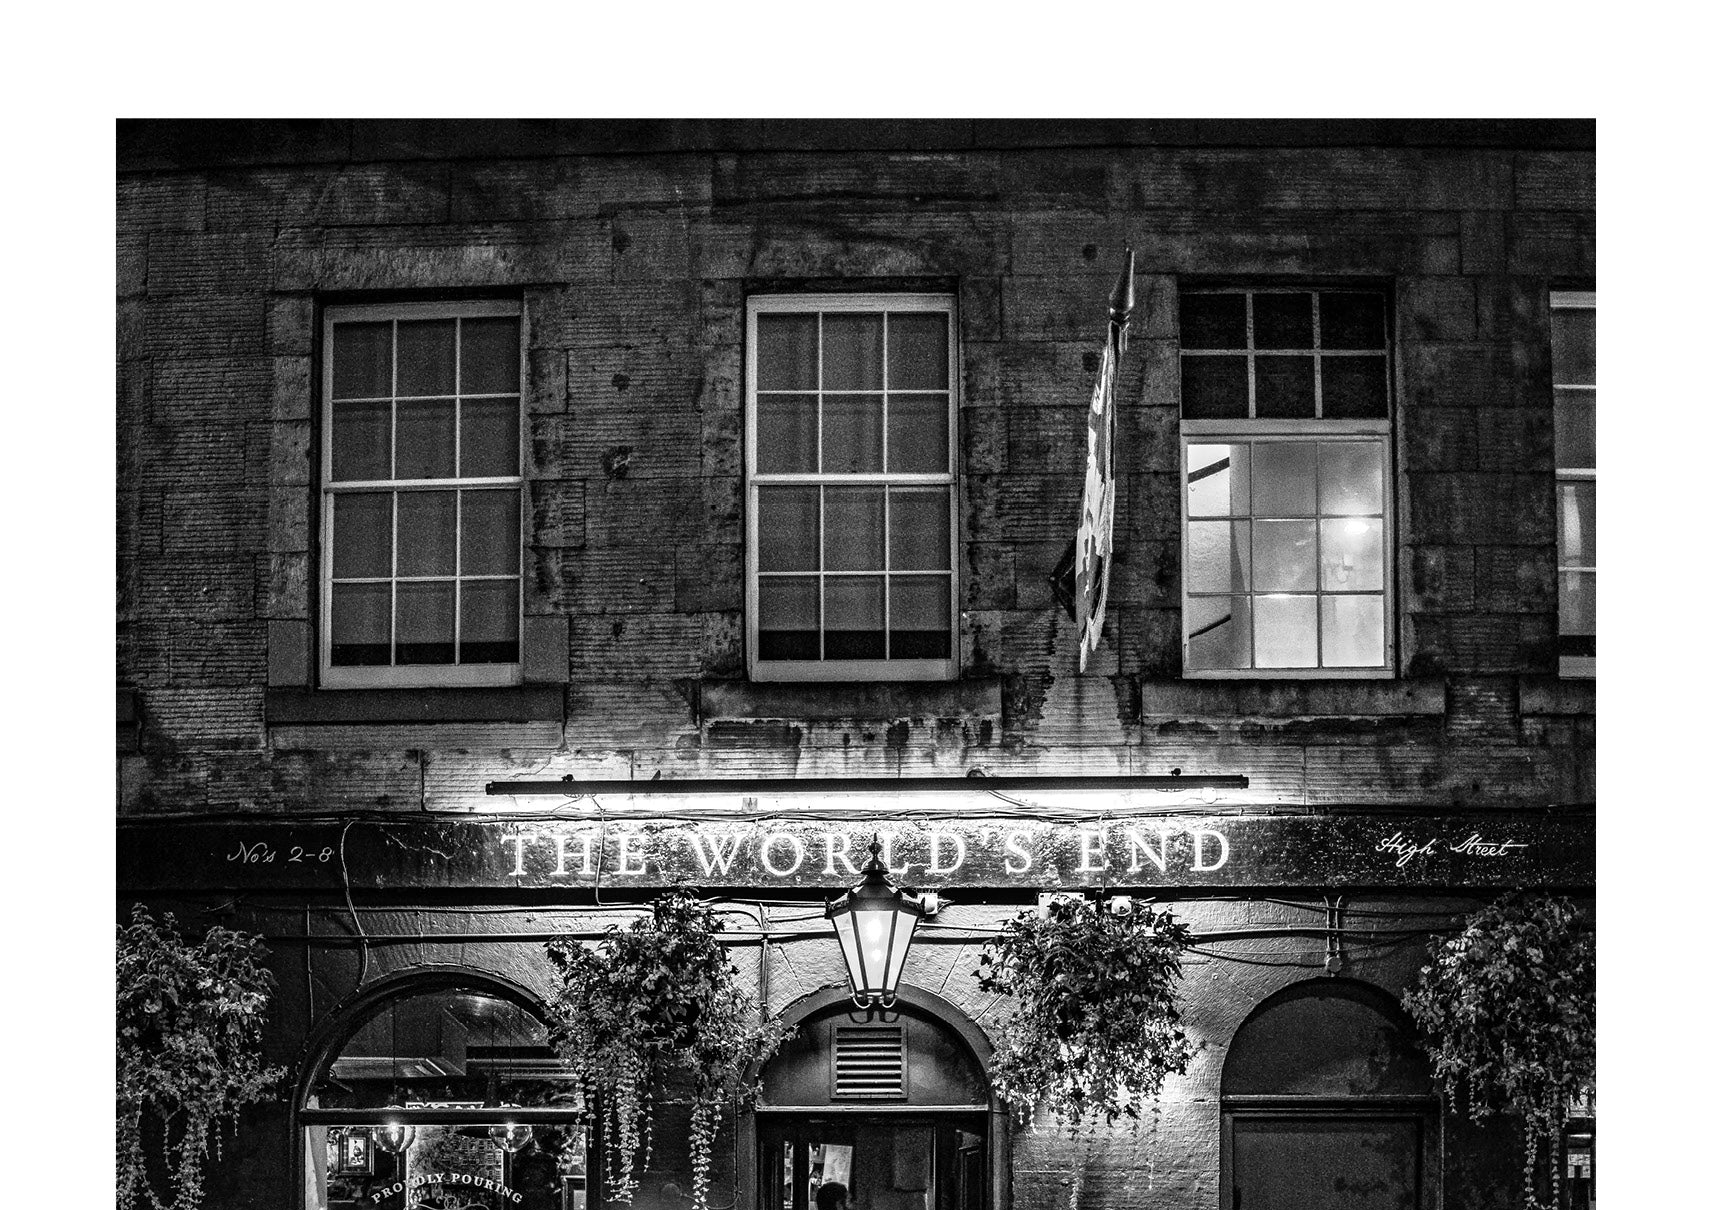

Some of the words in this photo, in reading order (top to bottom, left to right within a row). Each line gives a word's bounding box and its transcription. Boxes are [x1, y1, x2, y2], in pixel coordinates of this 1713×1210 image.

[227, 841, 276, 863] No's
[288, 846, 333, 863] 2-8
[500, 832, 647, 876] THE
[687, 831, 1033, 877] WORLD'S
[1074, 830, 1230, 873] END
[1375, 831, 1437, 868] High
[1450, 834, 1529, 856] Street
[371, 1172, 445, 1204] PROUDLY
[451, 1173, 523, 1204] POURING
